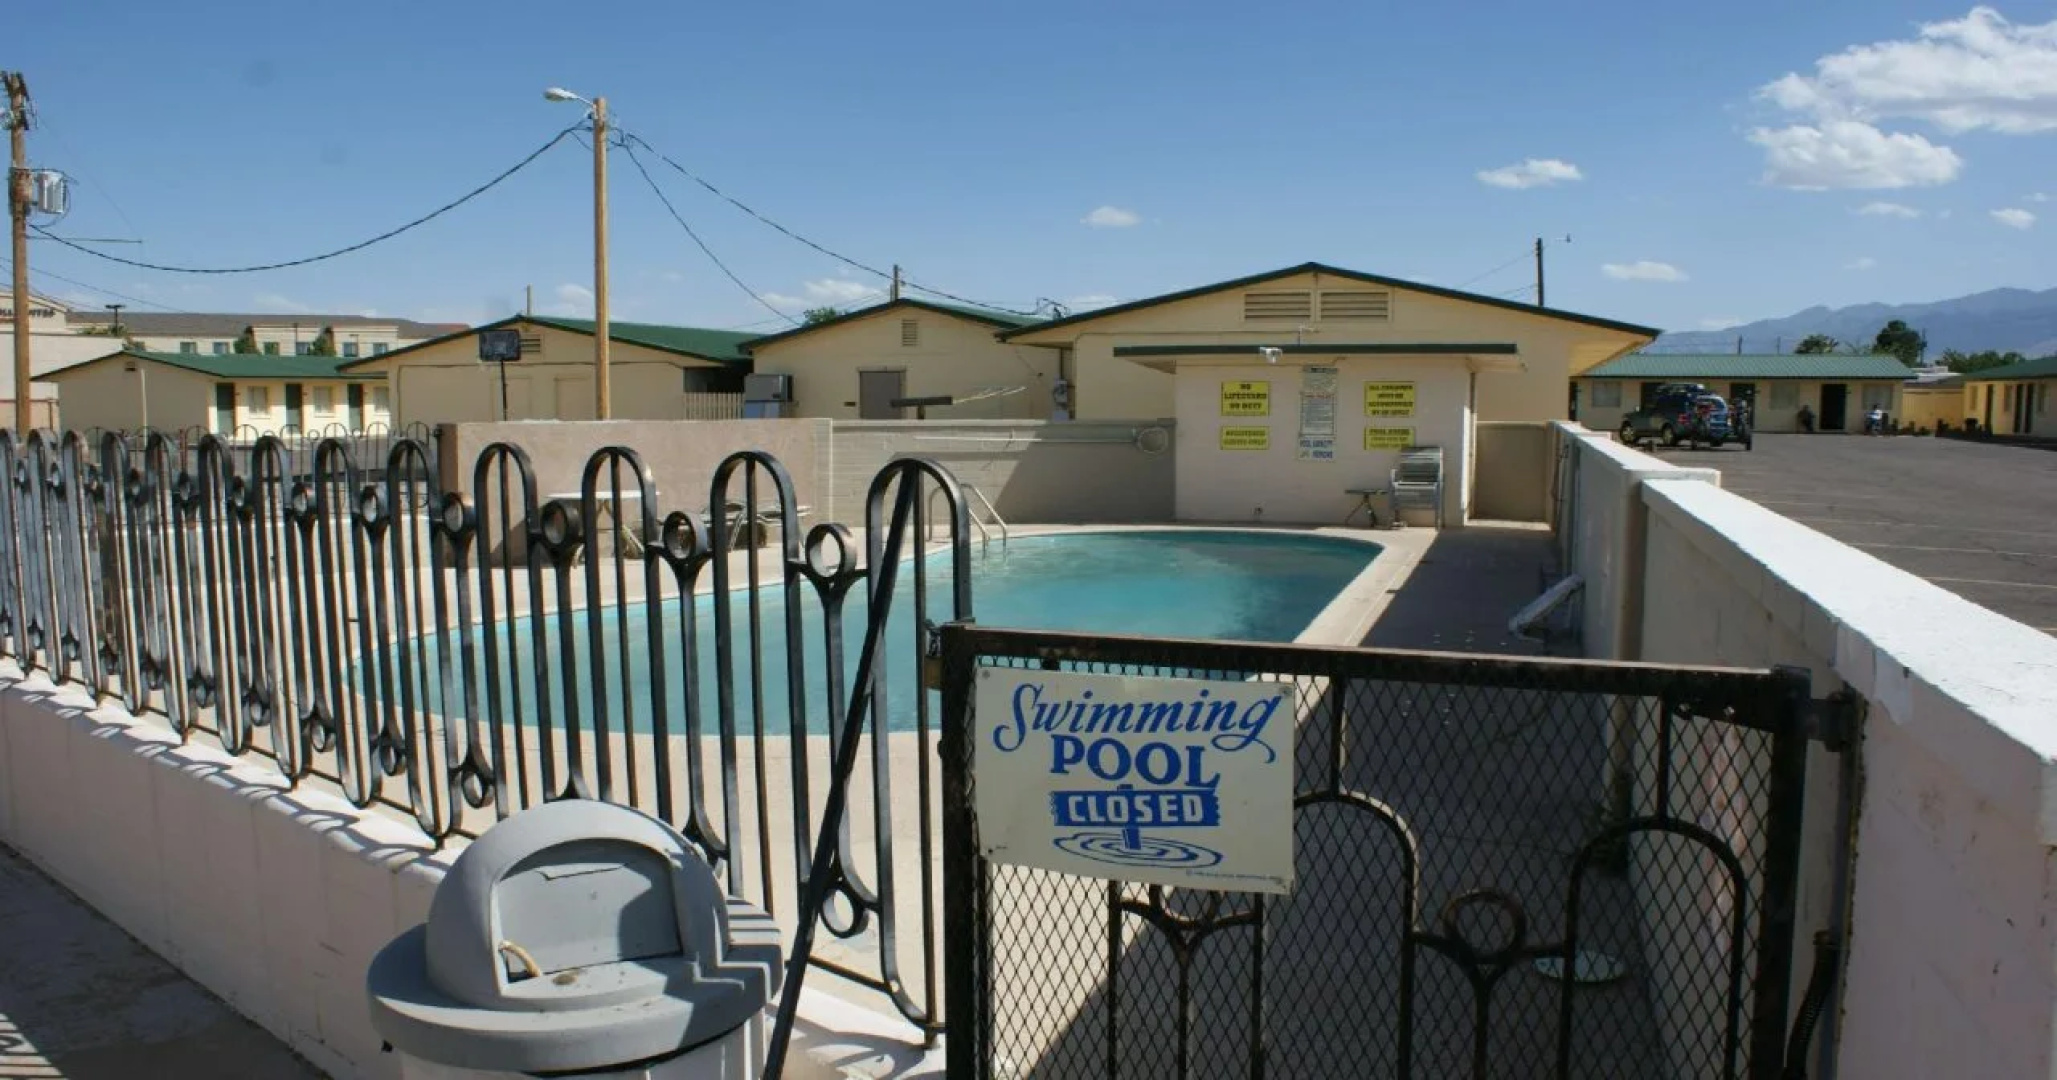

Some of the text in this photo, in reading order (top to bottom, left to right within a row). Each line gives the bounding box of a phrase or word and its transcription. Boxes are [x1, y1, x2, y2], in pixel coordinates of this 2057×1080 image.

[992, 682, 1282, 764] Swimming
[1050, 734, 1220, 788] POOL
[1068, 795, 1203, 824] CLOSED
